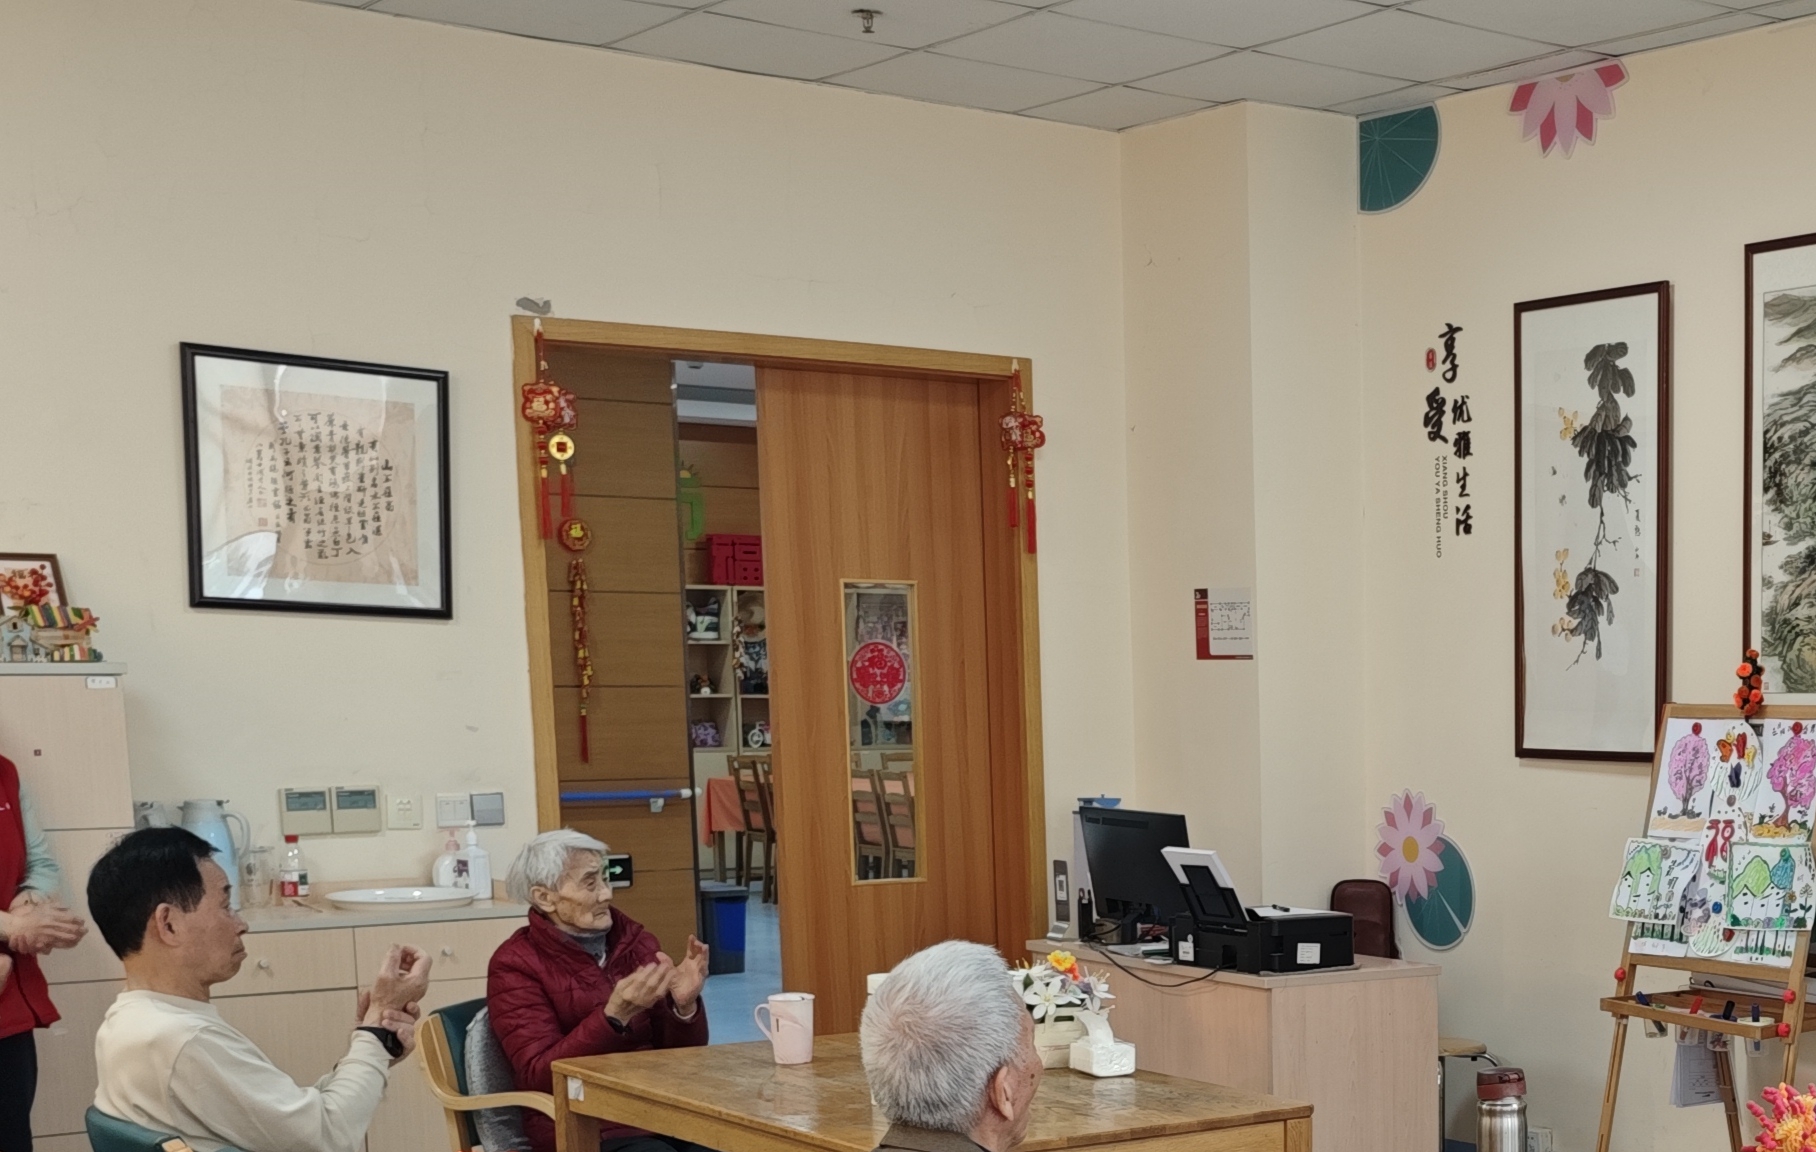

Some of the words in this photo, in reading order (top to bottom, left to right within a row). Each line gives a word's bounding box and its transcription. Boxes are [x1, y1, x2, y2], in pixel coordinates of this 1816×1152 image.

[1434, 480, 1441, 495] YA
[1451, 394, 1474, 537] 优雅生活
